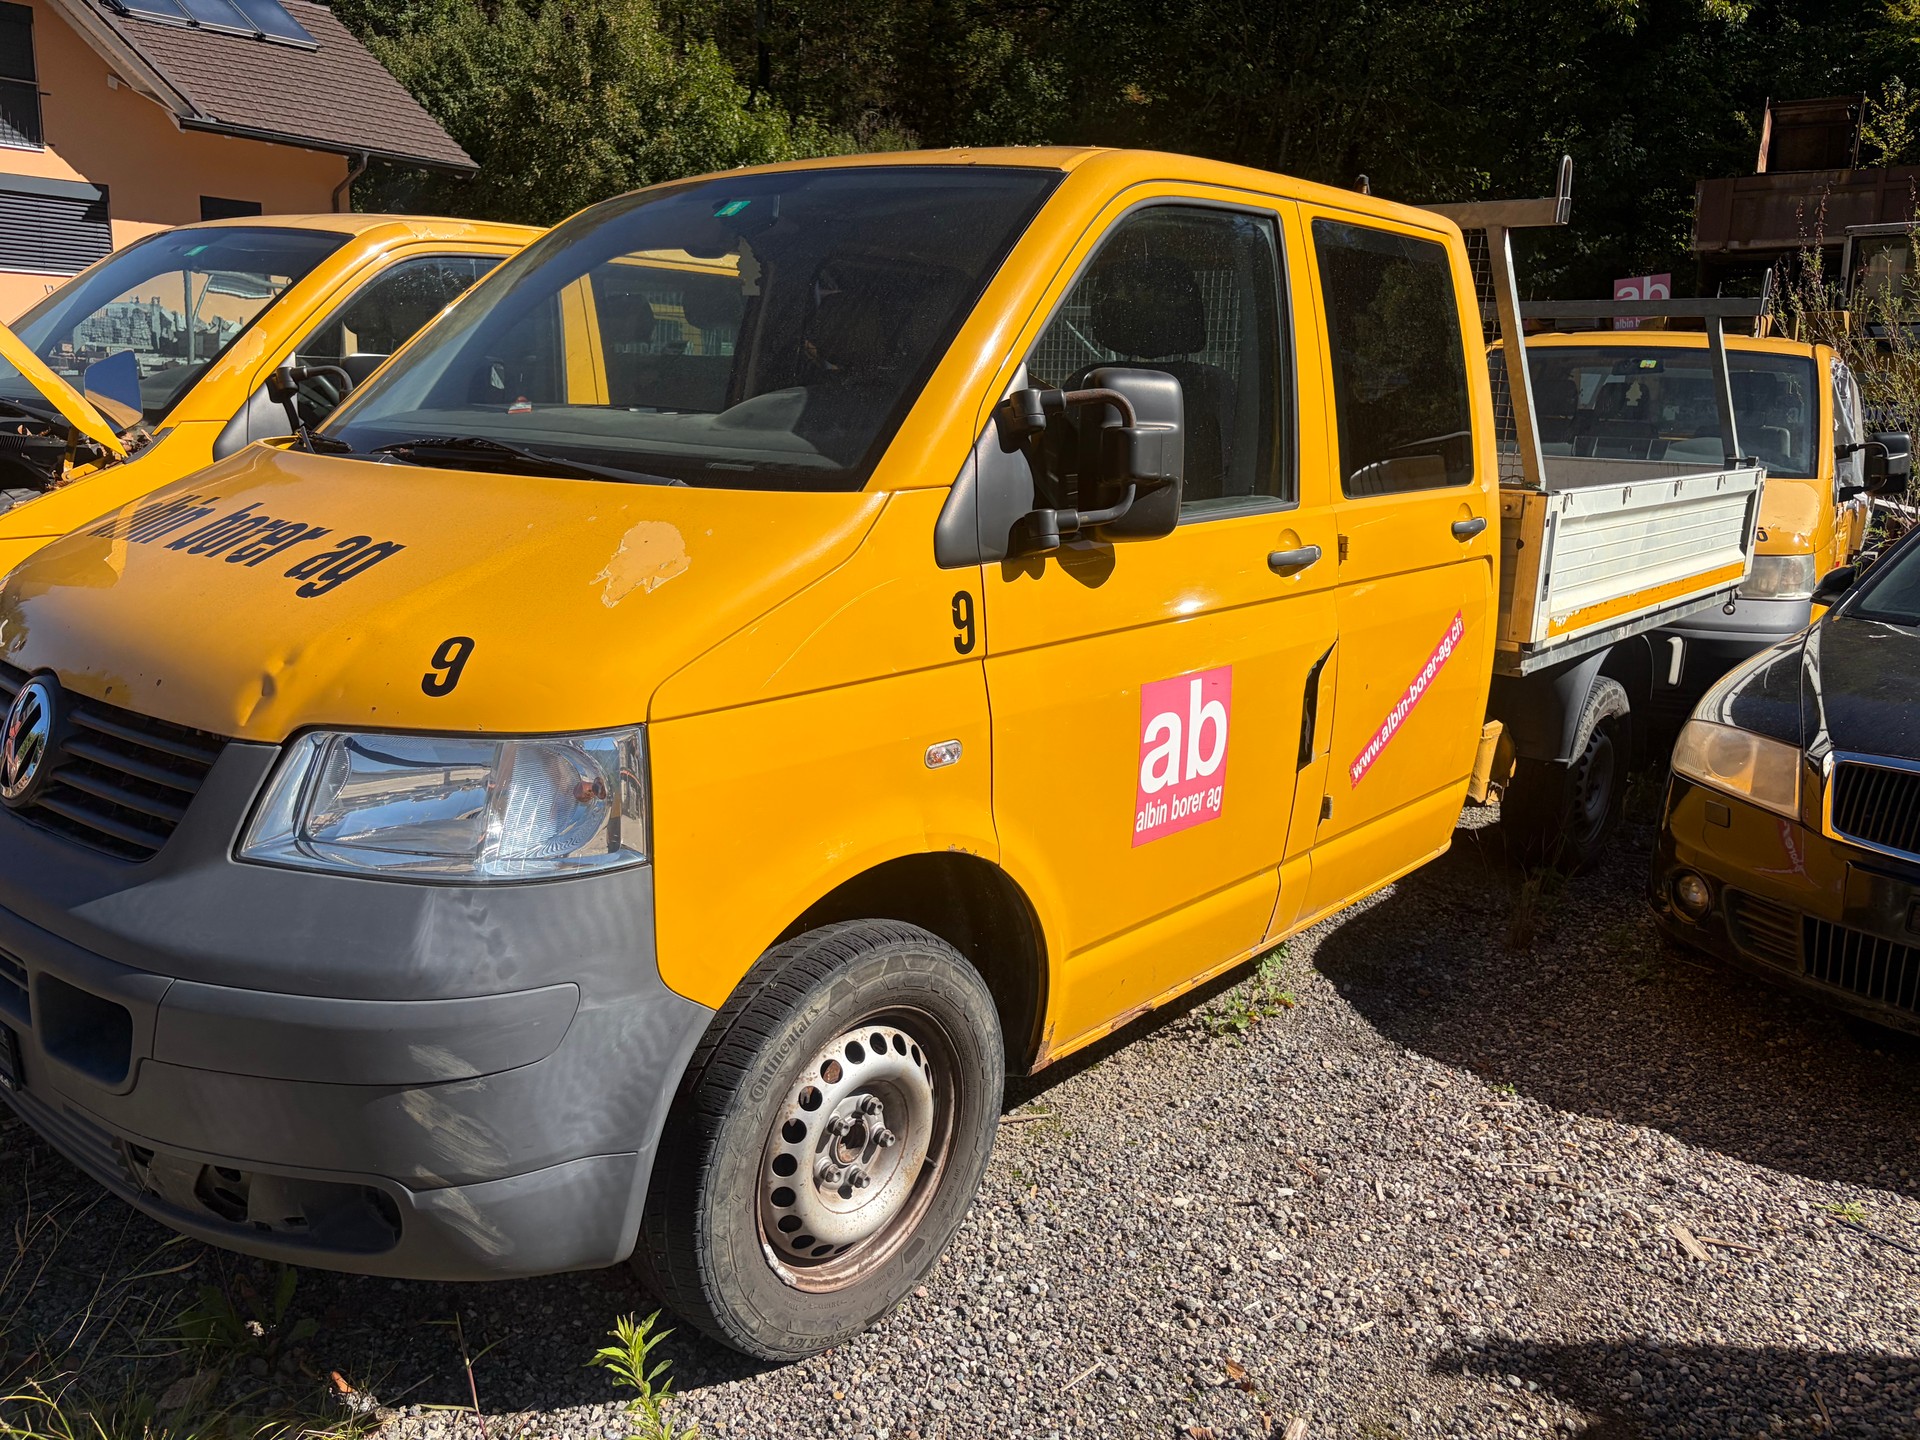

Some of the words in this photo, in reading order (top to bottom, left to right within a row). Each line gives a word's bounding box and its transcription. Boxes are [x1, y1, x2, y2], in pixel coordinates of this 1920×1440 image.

[1615, 318, 1634, 329] albin
[163, 502, 334, 567] borer
[283, 535, 407, 598] ag
[952, 590, 975, 655] 9
[421, 636, 475, 697] 9
[1352, 617, 1463, 780] www.albin-borer-ag.ch
[1140, 678, 1227, 794] ab
[1135, 800, 1168, 832] albin
[1171, 794, 1206, 821] borer
[1206, 785, 1222, 812] ag
[750, 1013, 812, 1102] Continental
